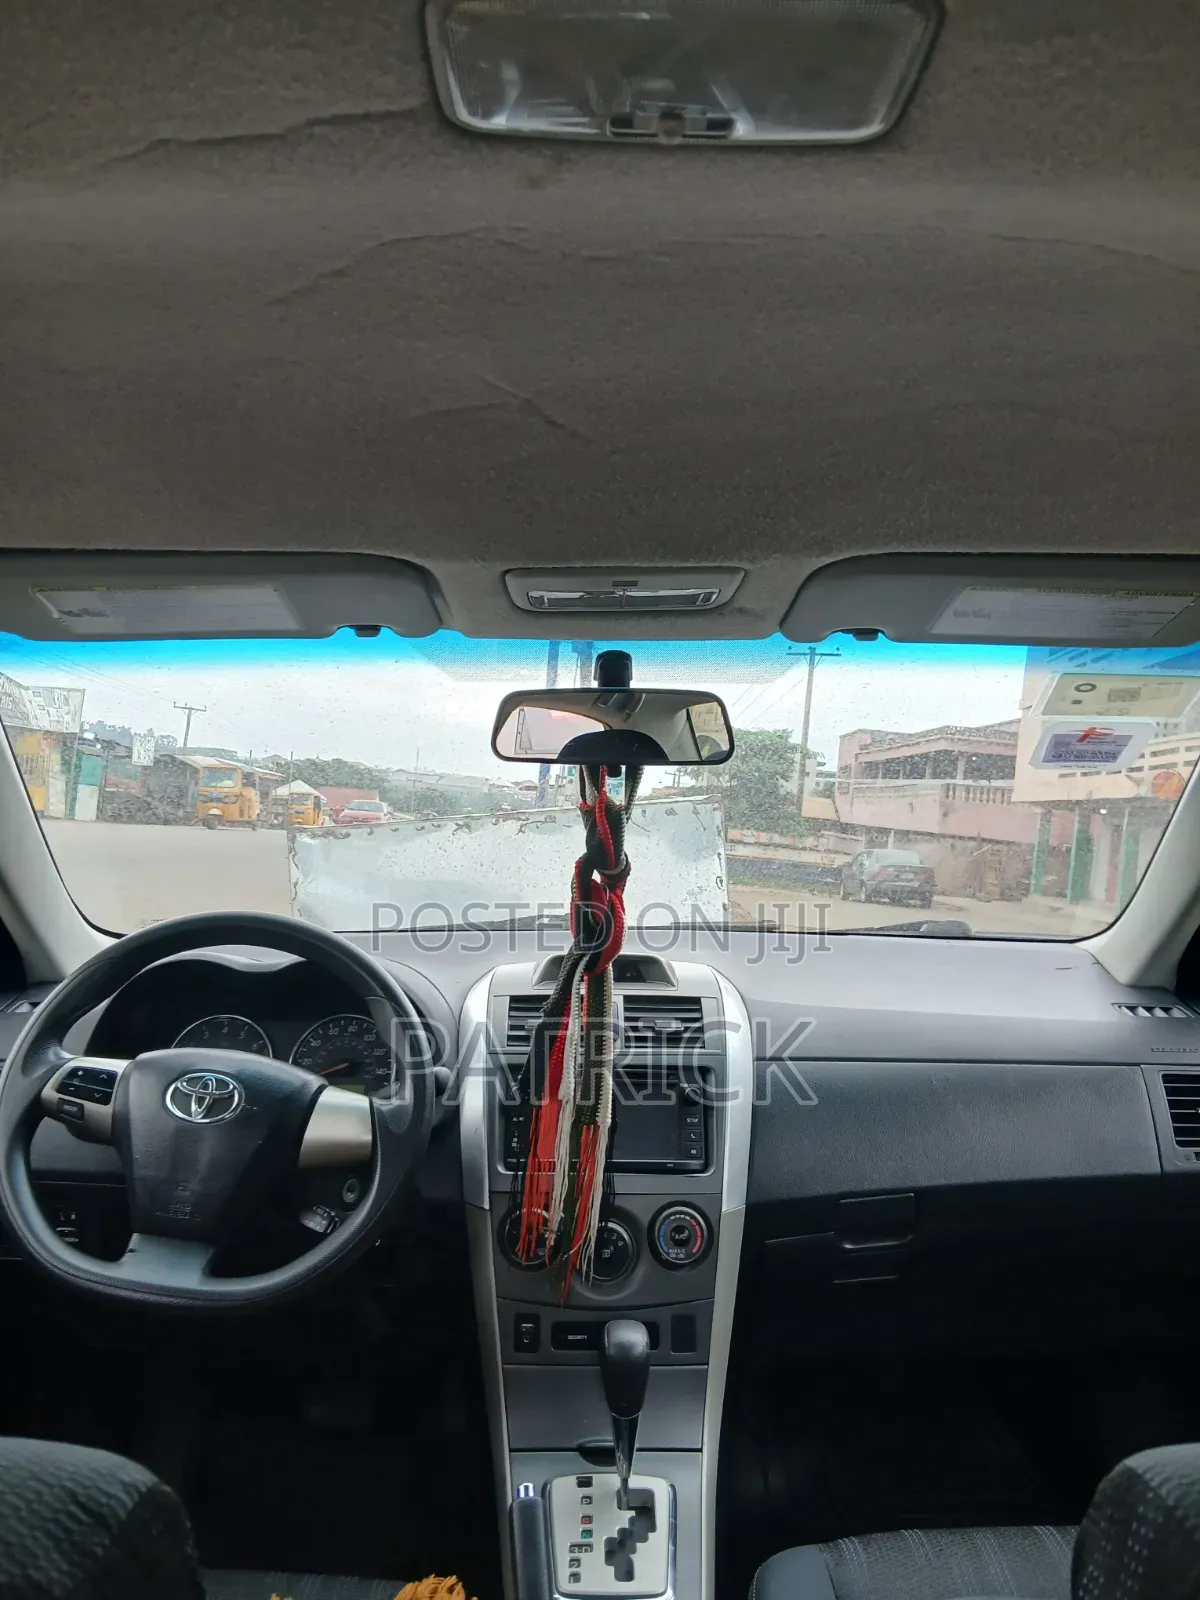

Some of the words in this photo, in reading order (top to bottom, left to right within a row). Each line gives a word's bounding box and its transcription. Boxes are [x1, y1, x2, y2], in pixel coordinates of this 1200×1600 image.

[363, 1034, 376, 1042] 100
[310, 1039, 321, 1047] 40
[375, 1067, 387, 1075] 140
